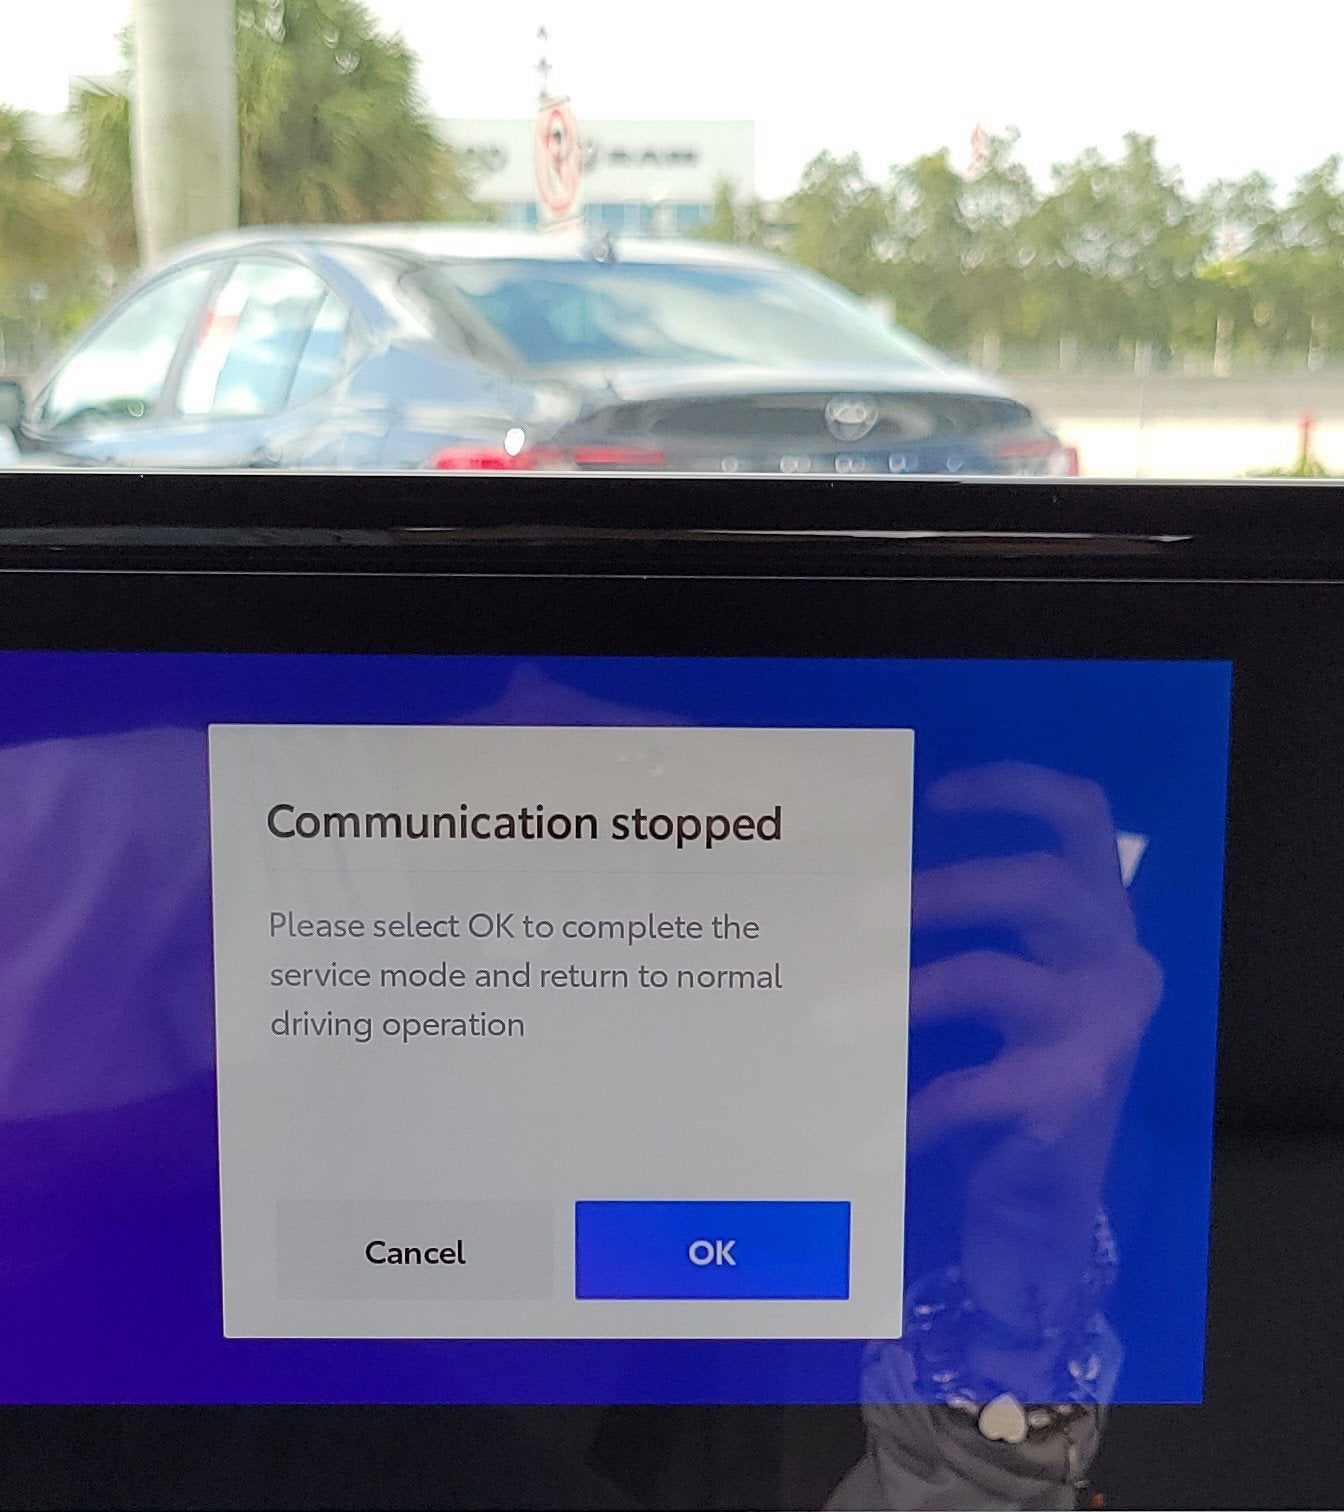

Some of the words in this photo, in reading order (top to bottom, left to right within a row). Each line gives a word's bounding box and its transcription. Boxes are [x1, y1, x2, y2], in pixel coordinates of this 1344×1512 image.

[266, 804, 598, 841] Communication
[611, 805, 783, 849] stopped
[269, 912, 365, 939] Please
[373, 913, 459, 939] select
[468, 914, 515, 939] OK
[523, 916, 554, 940] to
[562, 914, 703, 945] complete
[711, 914, 760, 940] the
[270, 963, 371, 988] service
[381, 961, 466, 988] mode
[475, 962, 531, 989] and
[540, 967, 628, 989] return
[638, 966, 669, 989] to
[677, 962, 783, 989] normal
[271, 1010, 373, 1043] driving
[382, 1012, 524, 1043] operation
[365, 1239, 466, 1266] Cancel
[688, 1239, 737, 1266] OK
